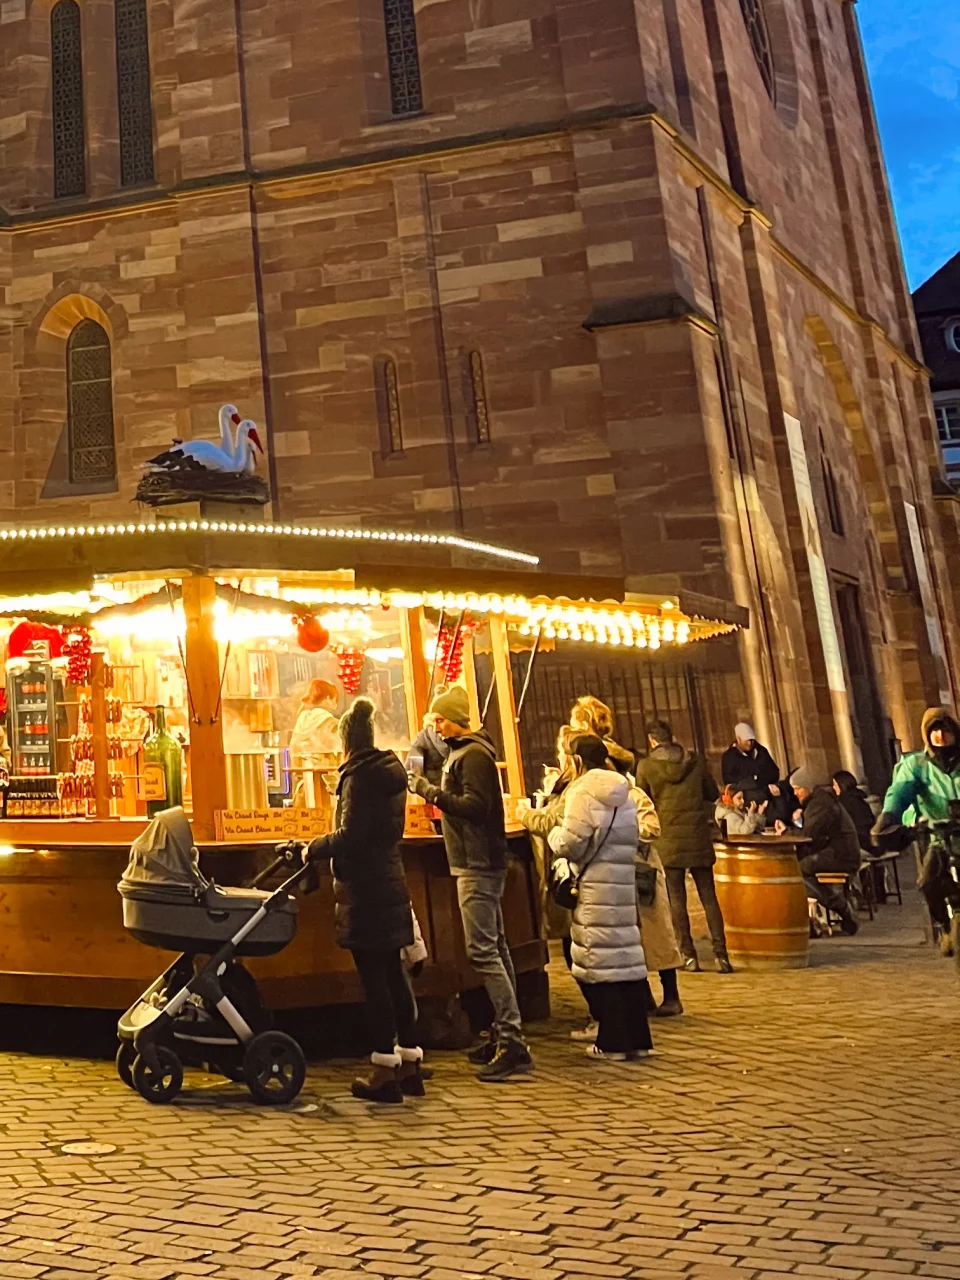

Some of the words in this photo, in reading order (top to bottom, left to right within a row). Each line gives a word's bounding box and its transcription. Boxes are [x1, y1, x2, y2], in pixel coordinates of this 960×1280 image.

[235, 811, 252, 819] Chaud
[254, 810, 269, 821] Rouge
[236, 825, 253, 833] Chaud
[255, 825, 271, 833] Blanc
